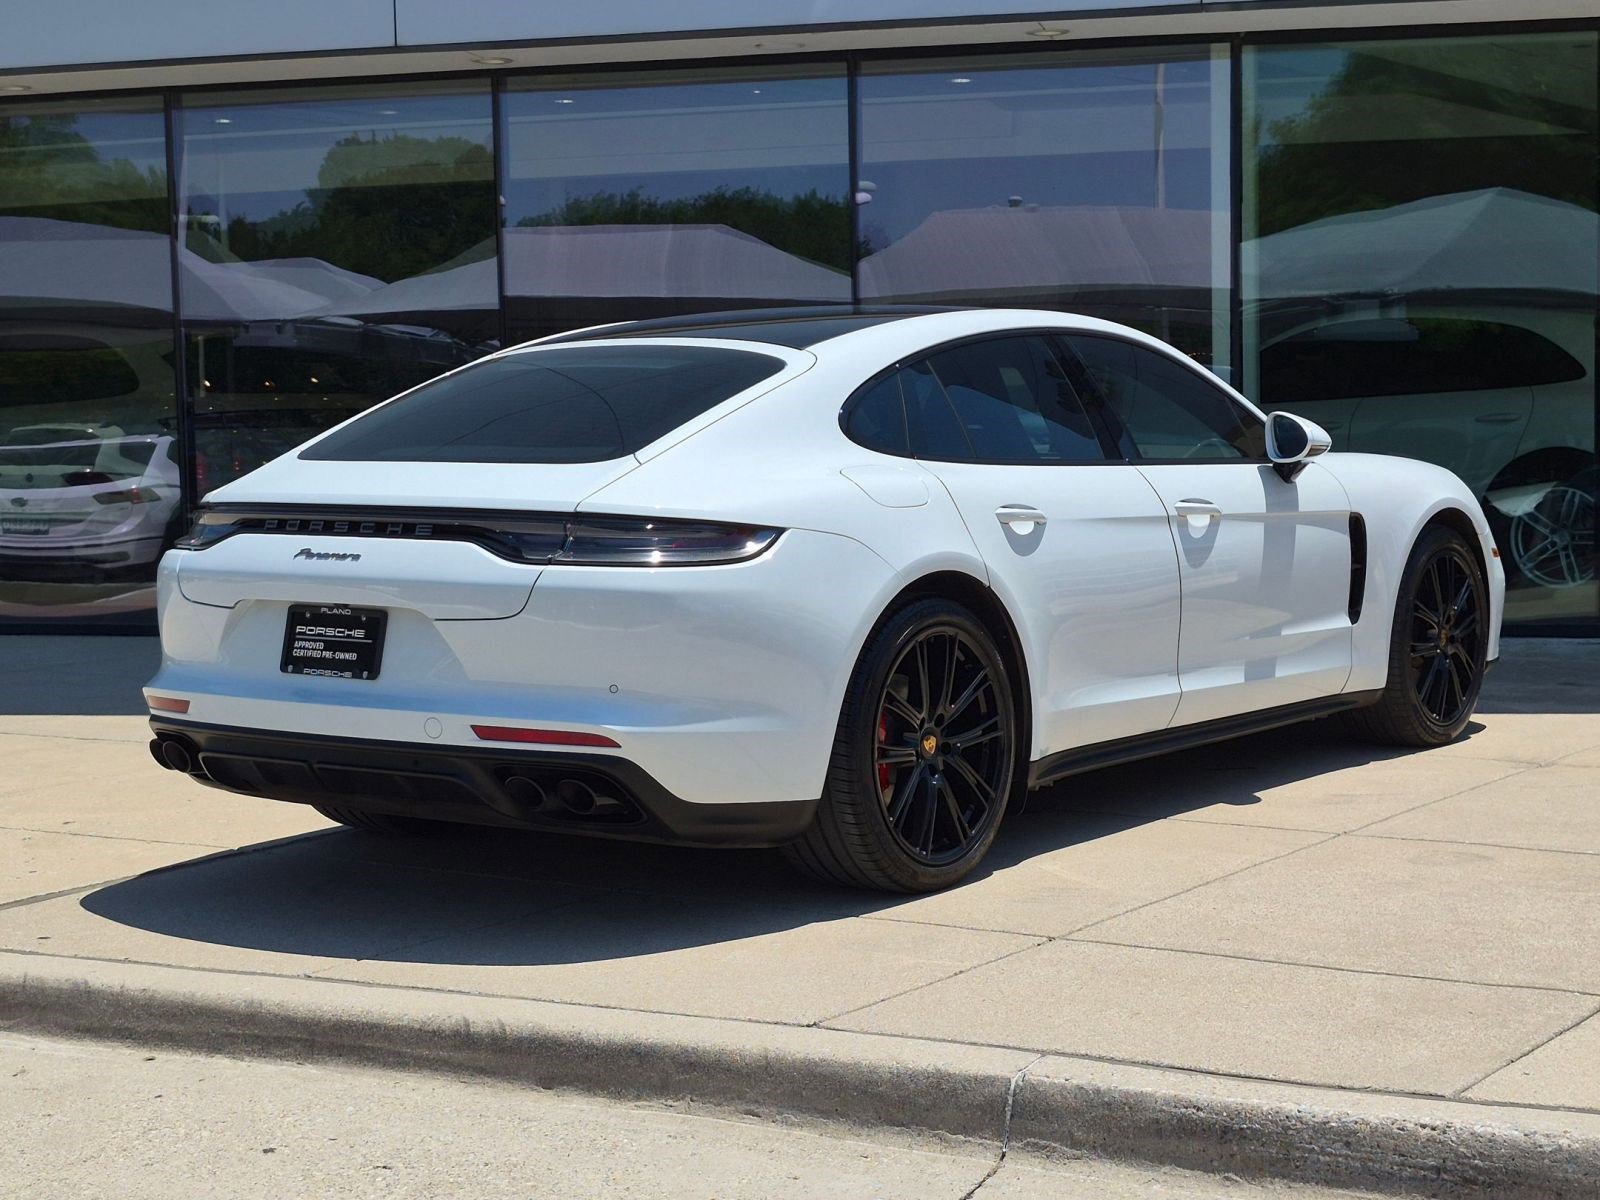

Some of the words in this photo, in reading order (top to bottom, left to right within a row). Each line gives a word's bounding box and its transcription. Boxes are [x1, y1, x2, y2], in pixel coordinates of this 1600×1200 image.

[263, 519, 433, 536] PORSCHE
[293, 548, 362, 562] Panamera
[320, 607, 352, 616] PLANO
[295, 626, 366, 638] PORSCHE
[294, 641, 324, 650] APPROVED
[292, 649, 321, 658] CERTIFIED
[321, 650, 358, 661] PRE-OWNED
[303, 668, 353, 678] PORSCHE
